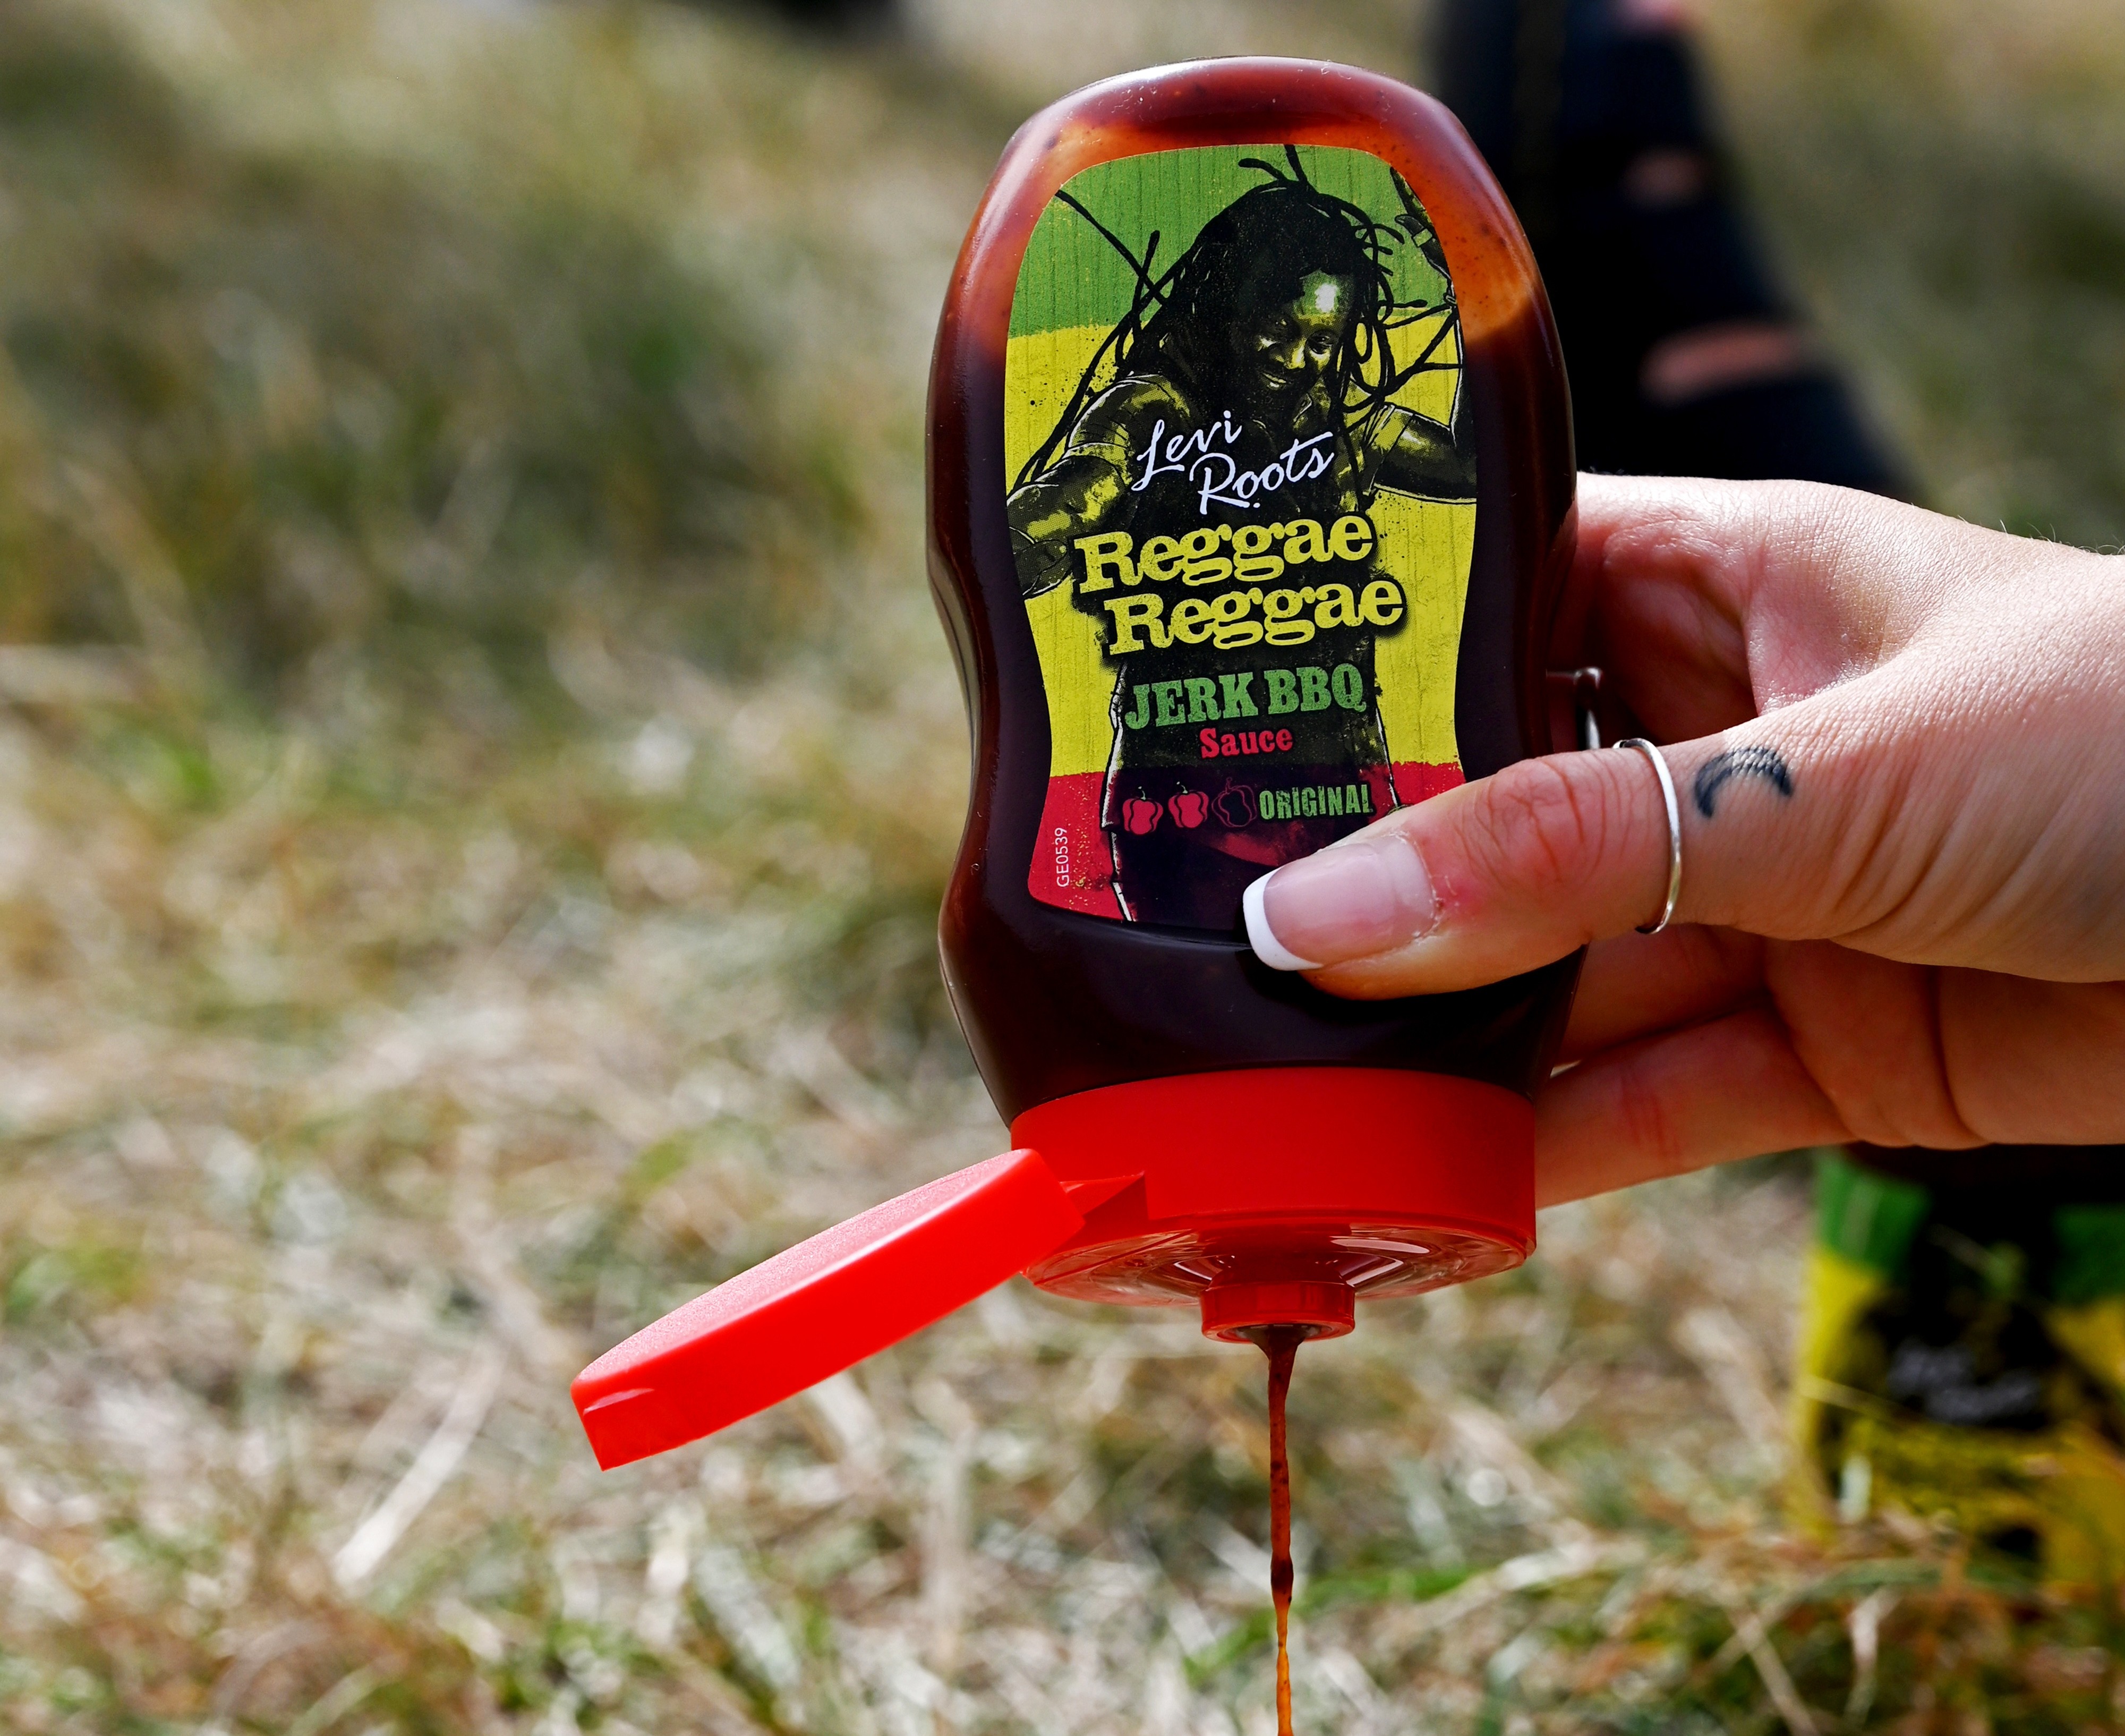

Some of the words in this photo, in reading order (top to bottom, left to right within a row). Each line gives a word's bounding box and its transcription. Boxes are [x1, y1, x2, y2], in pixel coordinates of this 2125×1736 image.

[1131, 410, 1242, 491] Levi
[1189, 431, 1335, 515] Roots
[1073, 515, 1373, 594] Reggae
[1104, 579, 1404, 656] Reggae
[1125, 672, 1259, 729] JERK
[1264, 662, 1368, 714] BBQ
[1199, 727, 1294, 759] Sauce
[1259, 784, 1373, 820] ORIGINAL
[1054, 827, 1070, 888] GE0539
